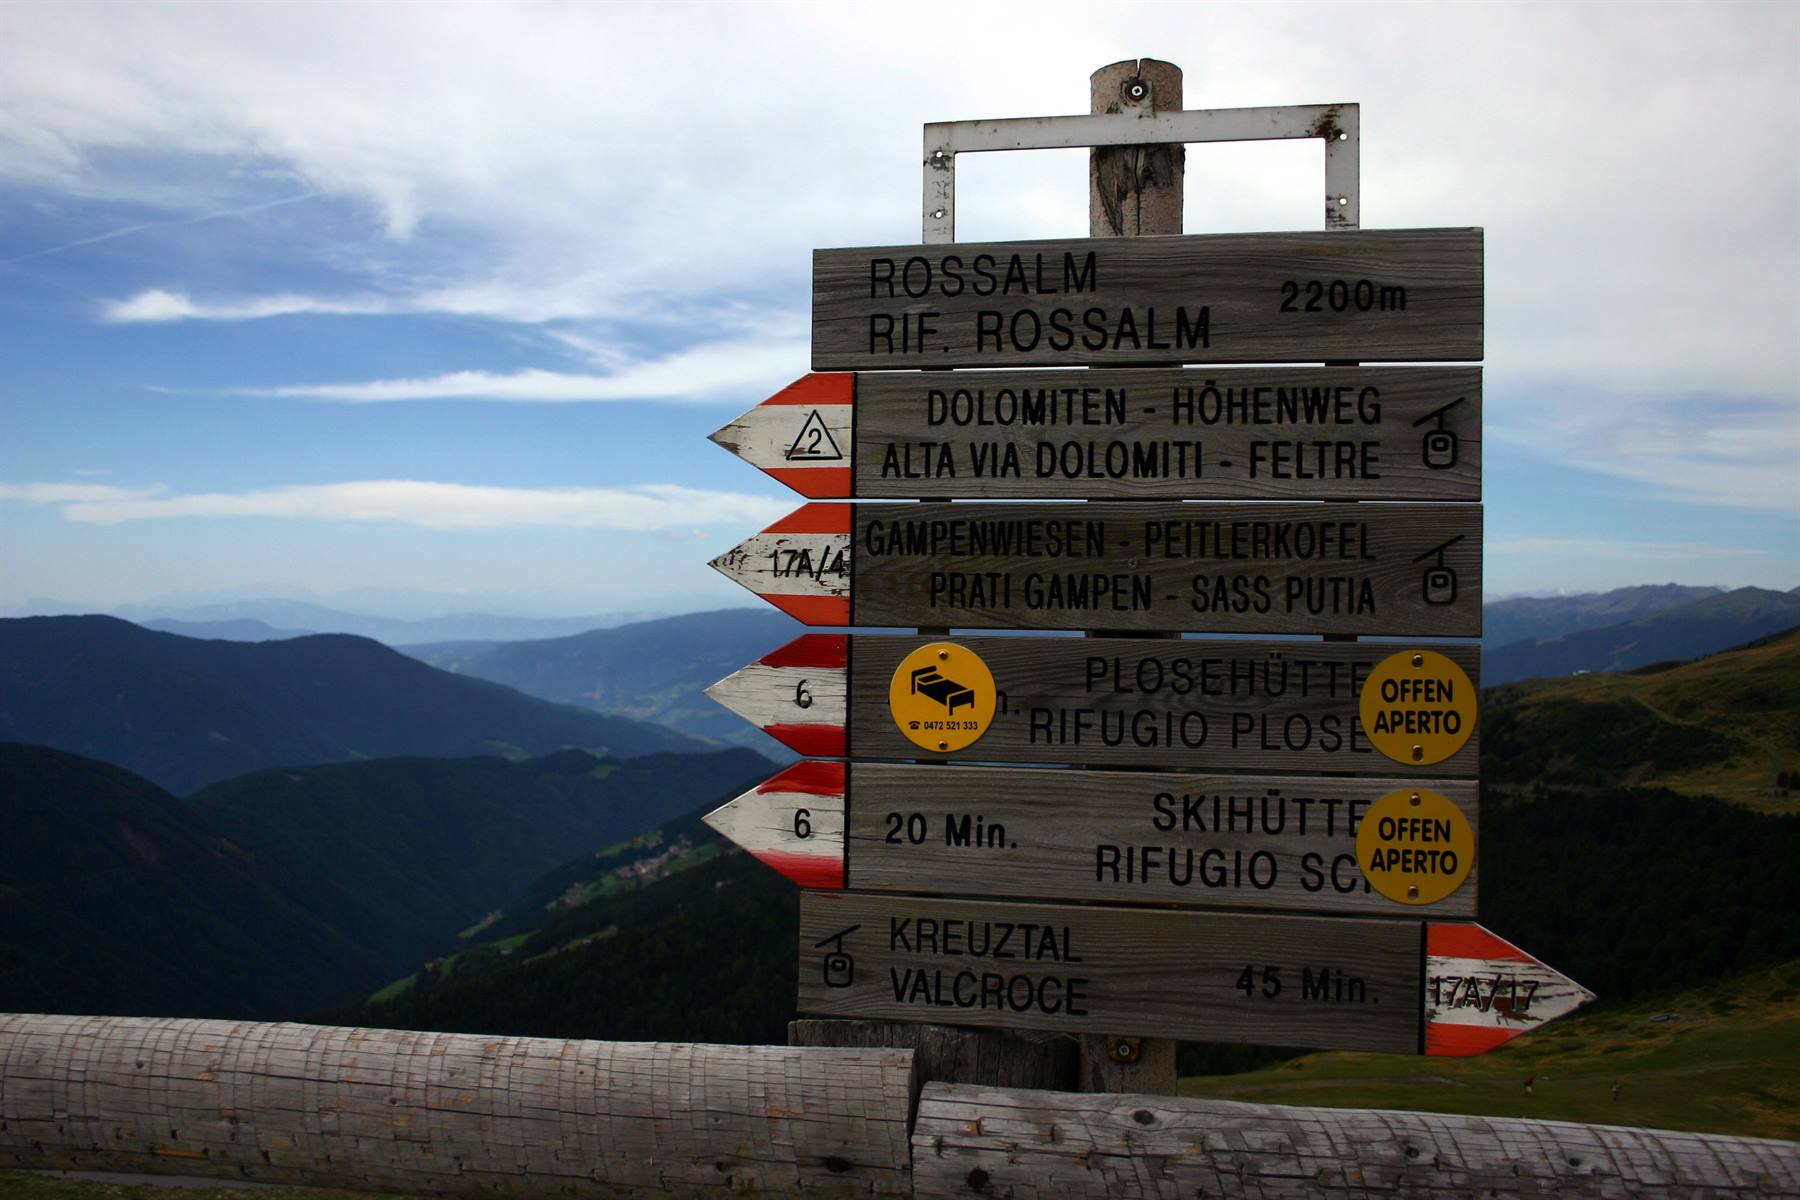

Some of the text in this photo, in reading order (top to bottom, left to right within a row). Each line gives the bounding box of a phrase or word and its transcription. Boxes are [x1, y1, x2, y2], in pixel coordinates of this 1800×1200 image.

[870, 251, 1096, 299] ROSSALM
[1280, 279, 1406, 312] 2200m
[869, 306, 1209, 354] RIF. ROSSALM
[928, 388, 1125, 426] DOLOMITEN
[1173, 380, 1381, 425] HÖHENWEG
[807, 428, 821, 454] 2
[881, 441, 955, 479] ALTA
[970, 441, 1021, 479] VIA
[1036, 440, 1202, 479] DOLOMITI
[1249, 441, 1380, 479] FELTRE
[865, 519, 1105, 558] GAMPENWIESEN
[1144, 521, 1377, 561] PEITLERKOFEL
[772, 545, 846, 582] 17A/4
[930, 572, 1010, 608] PRATI
[1024, 573, 1151, 612] GAMPEN
[1192, 574, 1271, 614] SASS
[1286, 576, 1376, 615] PUTIA
[795, 678, 813, 709] 6
[1086, 652, 1373, 698] PLOSEHÜTTE
[1381, 679, 1453, 703] OFFEN
[924, 721, 978, 731] 0472 521 333
[1030, 707, 1373, 753] RIFUGIO PLOSE
[1374, 710, 1461, 735] APERTO
[793, 808, 811, 838] 6
[885, 812, 1018, 849] 20 Min.
[1152, 789, 1372, 838] SKIHÜTTE
[1378, 816, 1451, 843] OFFEN
[1095, 844, 1371, 894] RIFUGIO SC
[1370, 848, 1458, 875] APERTO
[890, 917, 1083, 963] KREUZTAL
[890, 967, 1089, 1016] VALCROCE
[1235, 964, 1380, 1005] 45 Min.
[1429, 974, 1540, 1013] 17A/17
